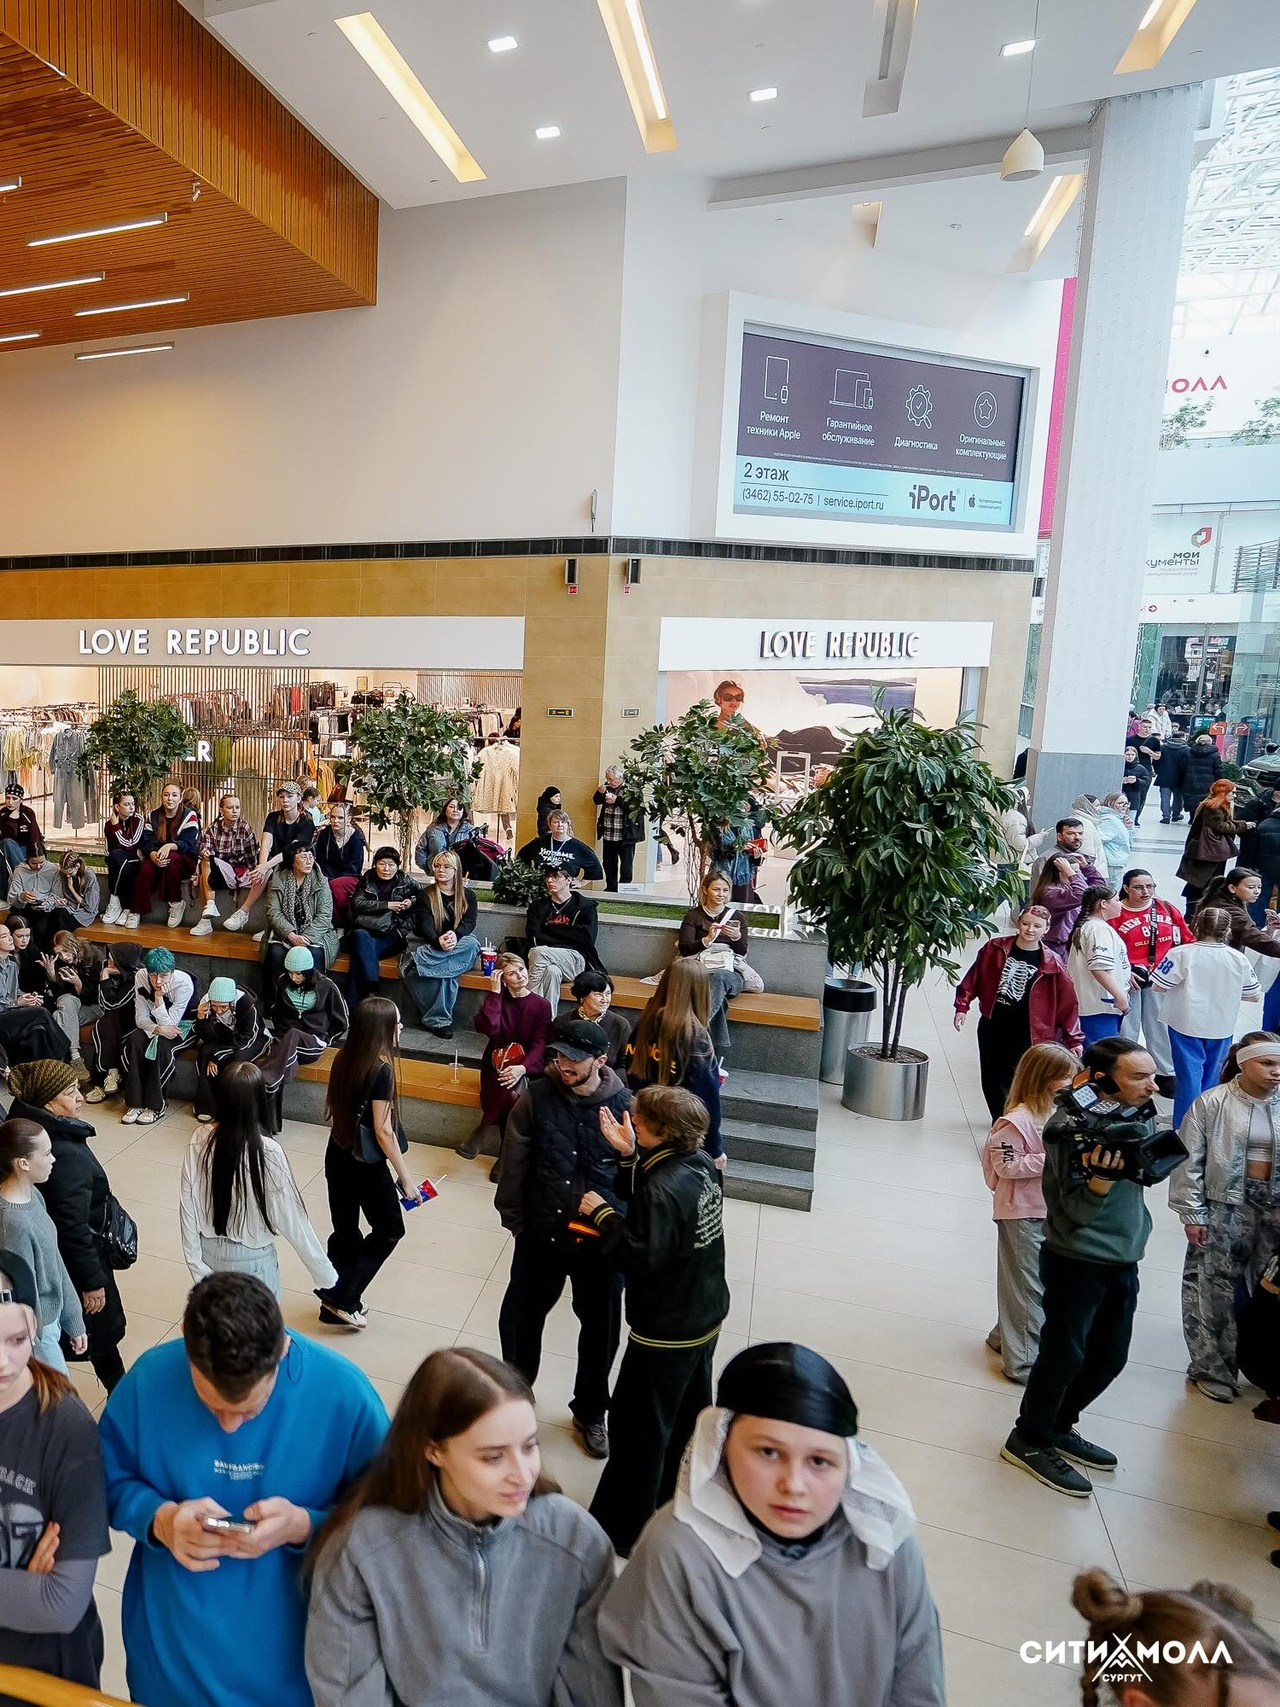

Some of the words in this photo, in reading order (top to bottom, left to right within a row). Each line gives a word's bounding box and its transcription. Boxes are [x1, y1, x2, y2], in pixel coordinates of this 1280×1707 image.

[1165, 375, 1228, 394] ОЛЛ
[760, 410, 789, 424] Ремонт
[826, 417, 873, 432] Гарантийное
[746, 425, 778, 437] техники
[779, 428, 801, 441] Apple
[822, 431, 875, 446] обслуживание
[959, 433, 1006, 448] Оригинальные
[894, 436, 939, 451] Диагностика
[955, 447, 1007, 461] комплектующие
[743, 462, 753, 478] 2
[755, 466, 790, 481] этаж
[742, 487, 772, 503] (3462)
[772, 490, 814, 504] 55-02-75
[823, 496, 884, 511] service.iport.ru
[909, 484, 957, 512] iPort
[79, 628, 149, 655] LOVE
[167, 628, 312, 656] REPUBLIC
[760, 631, 817, 658] LOVE
[826, 631, 920, 658] REPUBLIC
[1118, 916, 1142, 934] NEW
[1143, 913, 1173, 925] YRK
[1158, 935, 1173, 943] TEAM
